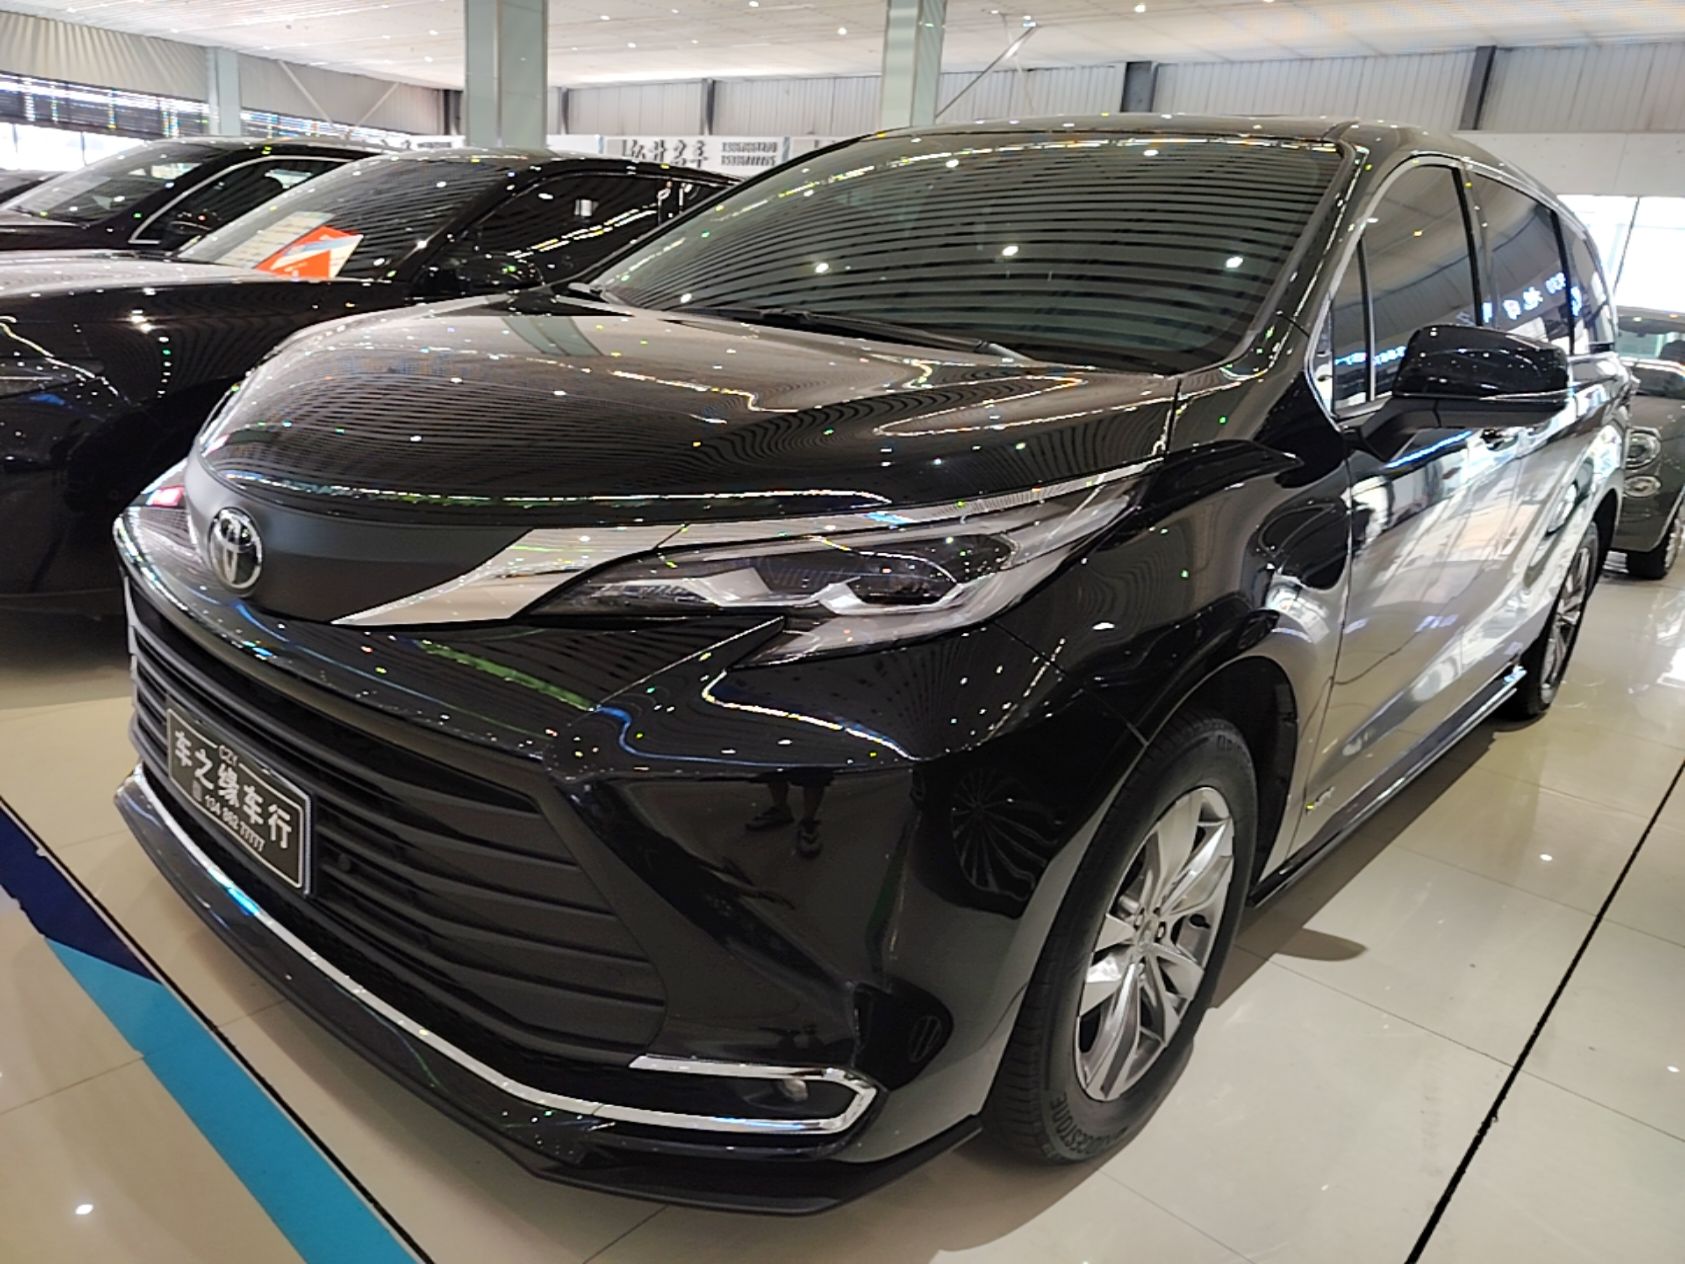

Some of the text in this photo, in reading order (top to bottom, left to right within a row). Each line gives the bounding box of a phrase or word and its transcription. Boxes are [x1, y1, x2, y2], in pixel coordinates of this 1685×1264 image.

[174, 730, 292, 849] 车之缘车行
